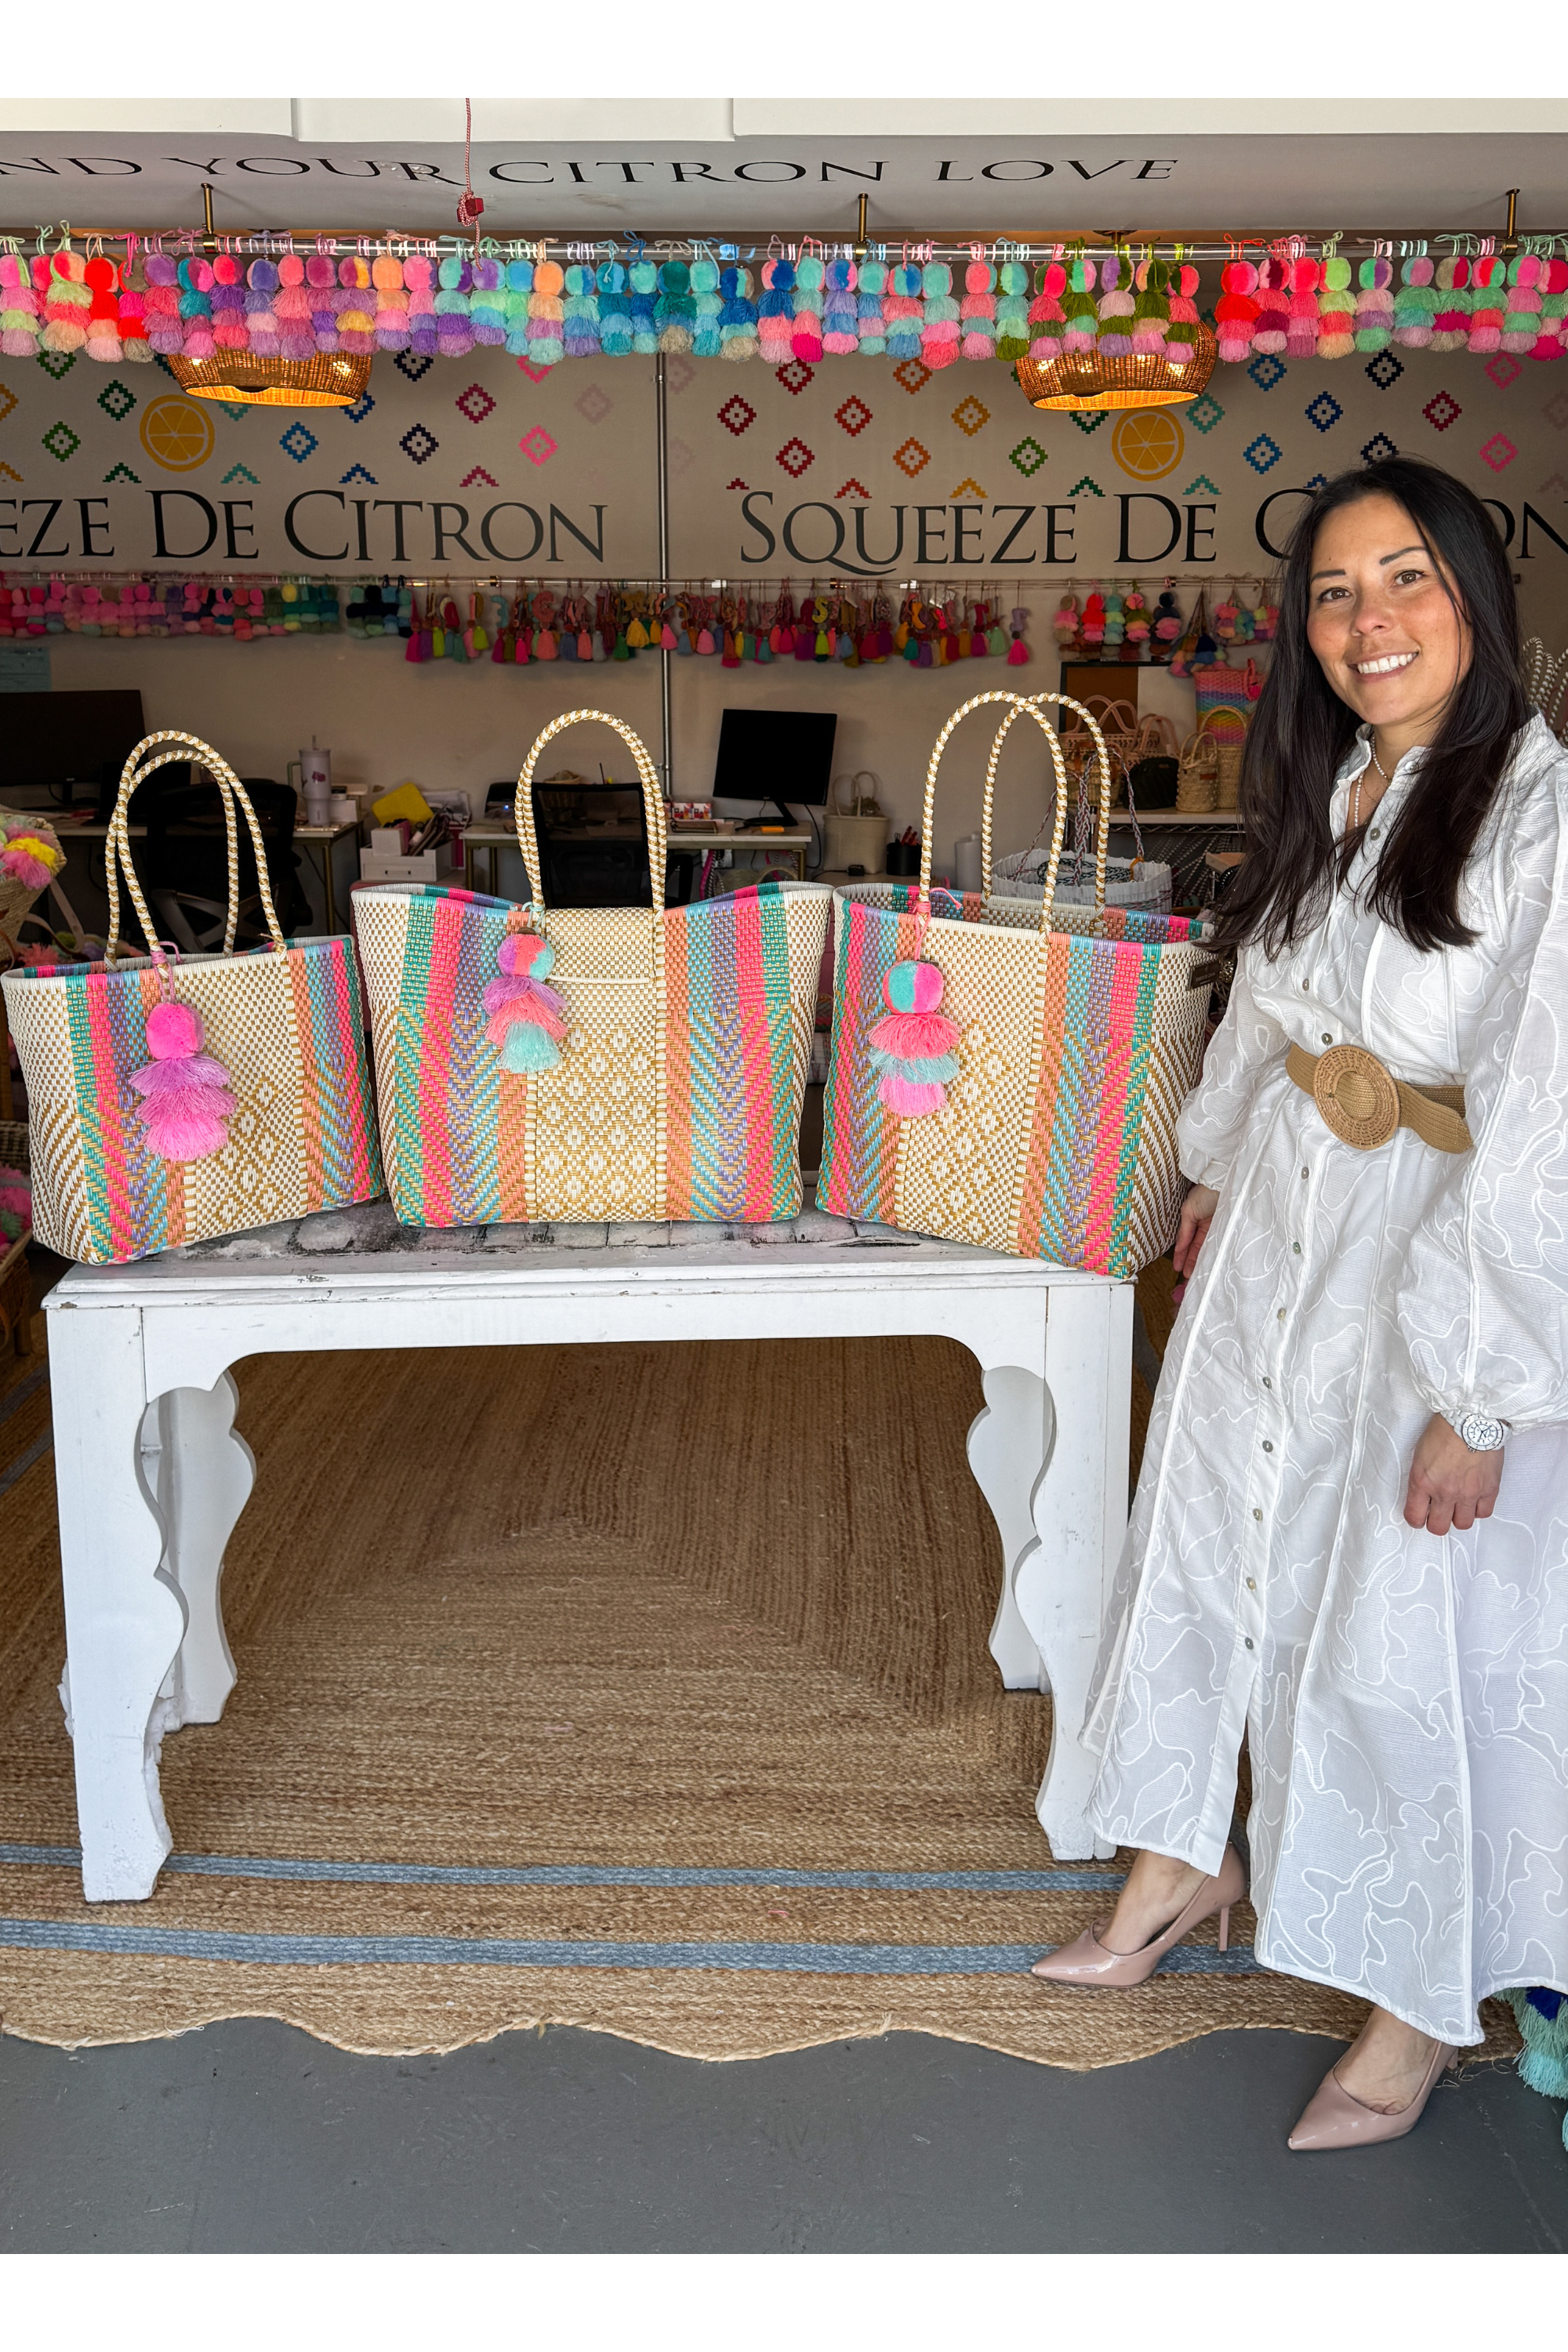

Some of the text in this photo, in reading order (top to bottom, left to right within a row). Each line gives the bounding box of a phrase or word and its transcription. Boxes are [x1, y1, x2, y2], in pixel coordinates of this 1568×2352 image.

[162, 158, 468, 186] YOUR
[488, 162, 889, 183] CITRON
[935, 160, 1178, 181] LOVE
[740, 491, 1077, 576] SQUEEZE
